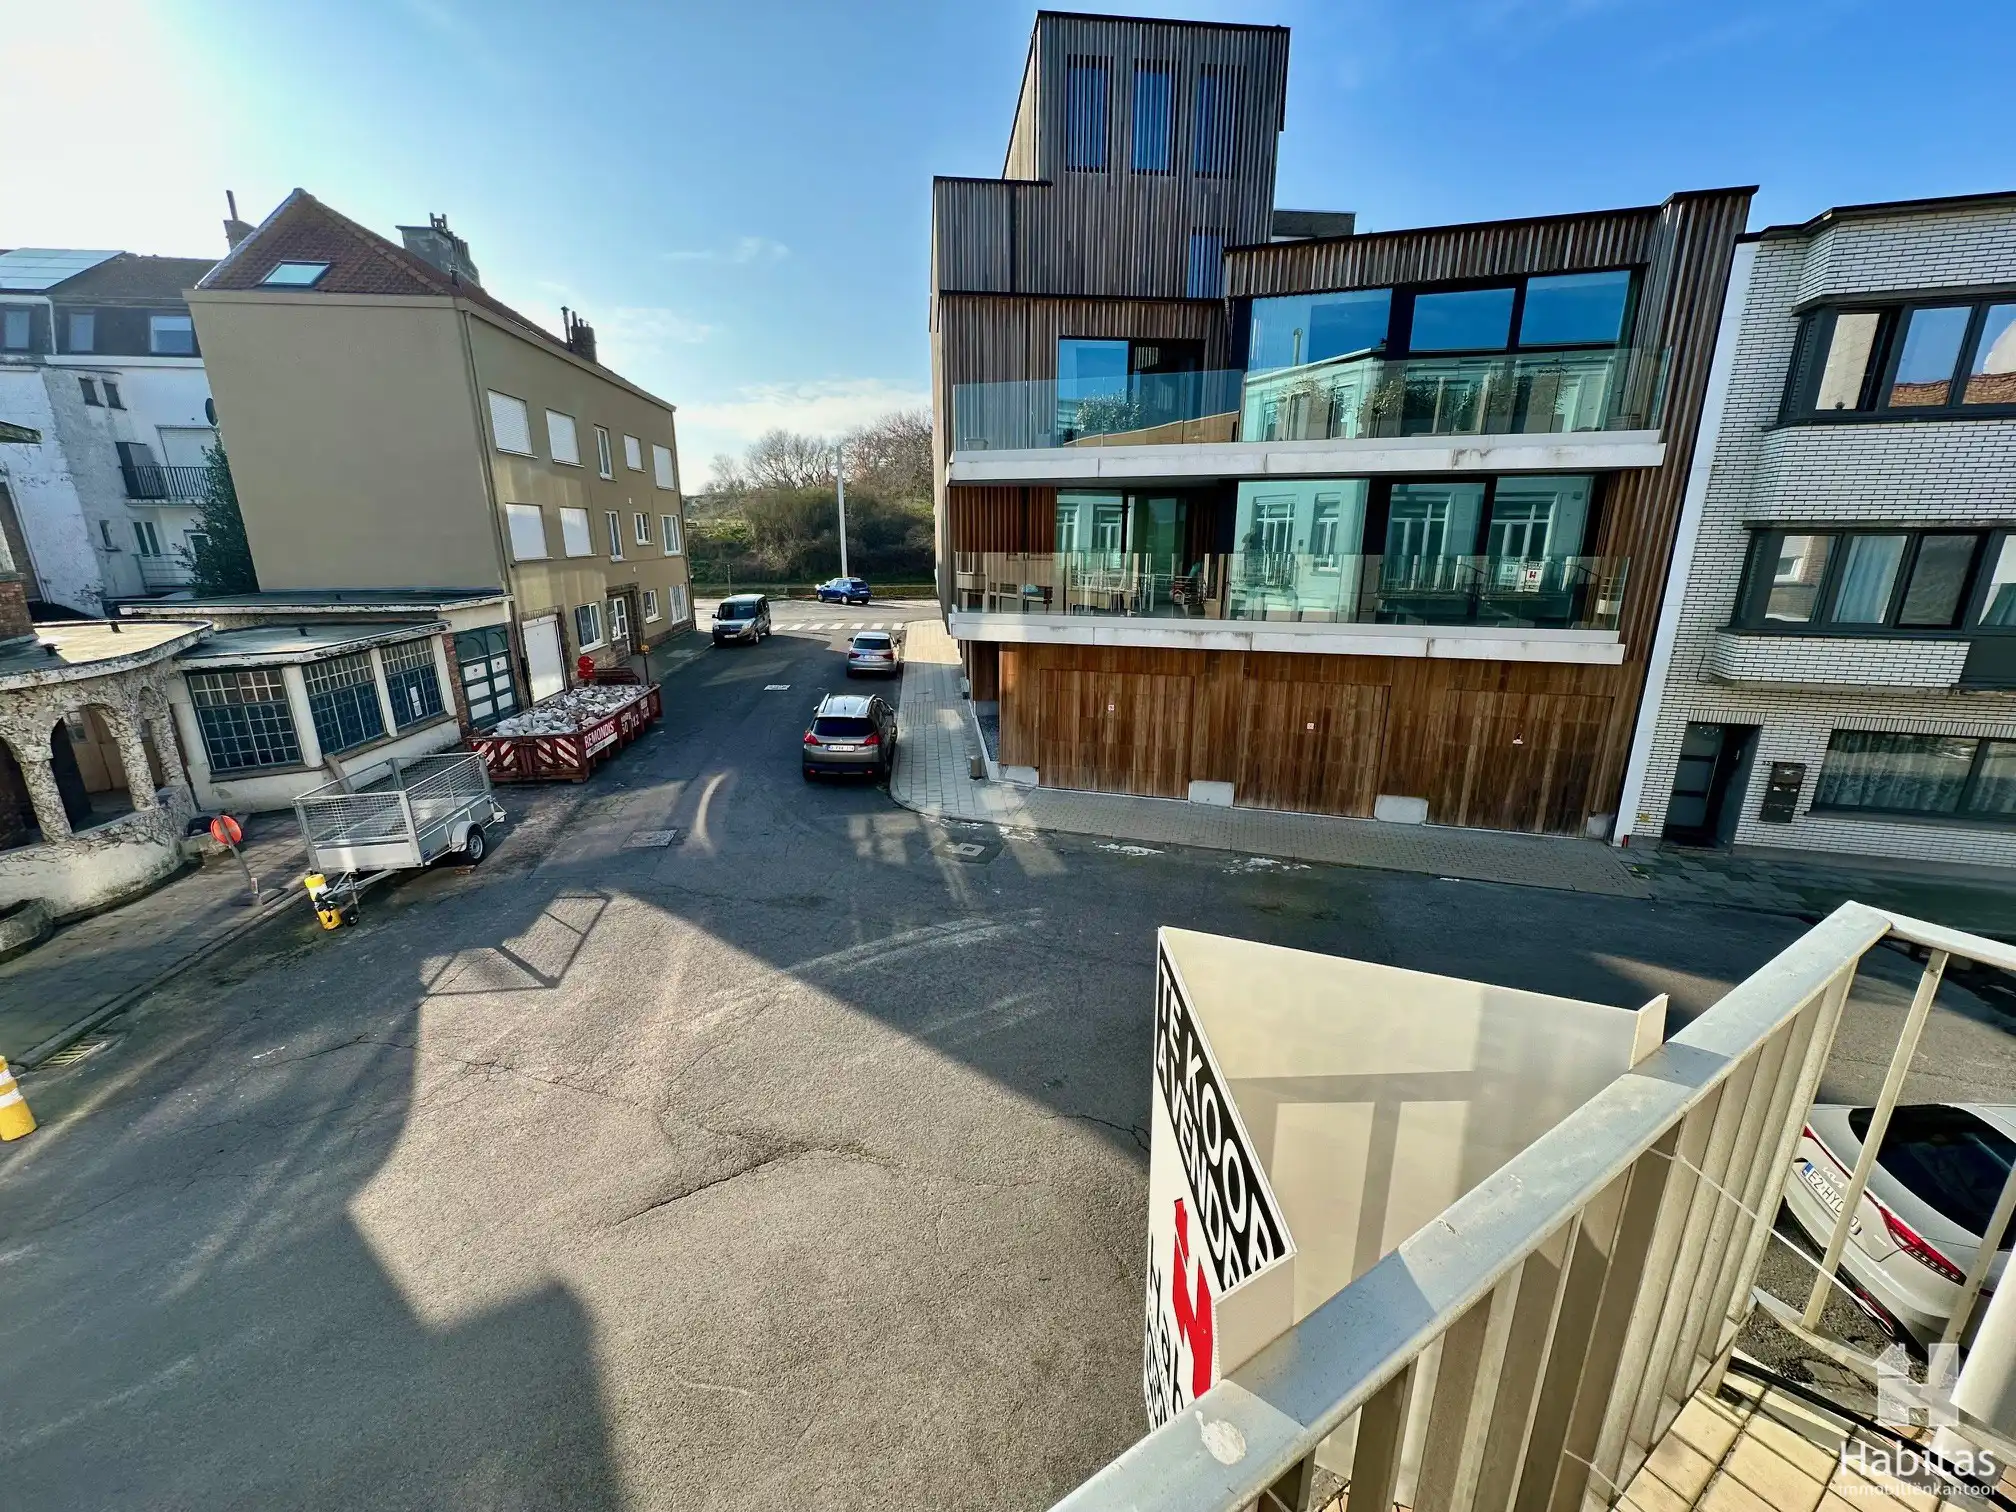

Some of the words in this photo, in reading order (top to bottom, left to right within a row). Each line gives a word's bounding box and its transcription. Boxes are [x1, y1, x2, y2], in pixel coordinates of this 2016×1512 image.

[584, 720, 615, 749] REMONDIS
[1160, 959, 1182, 1064] TE
[1185, 1031, 1275, 1274] KOOP
